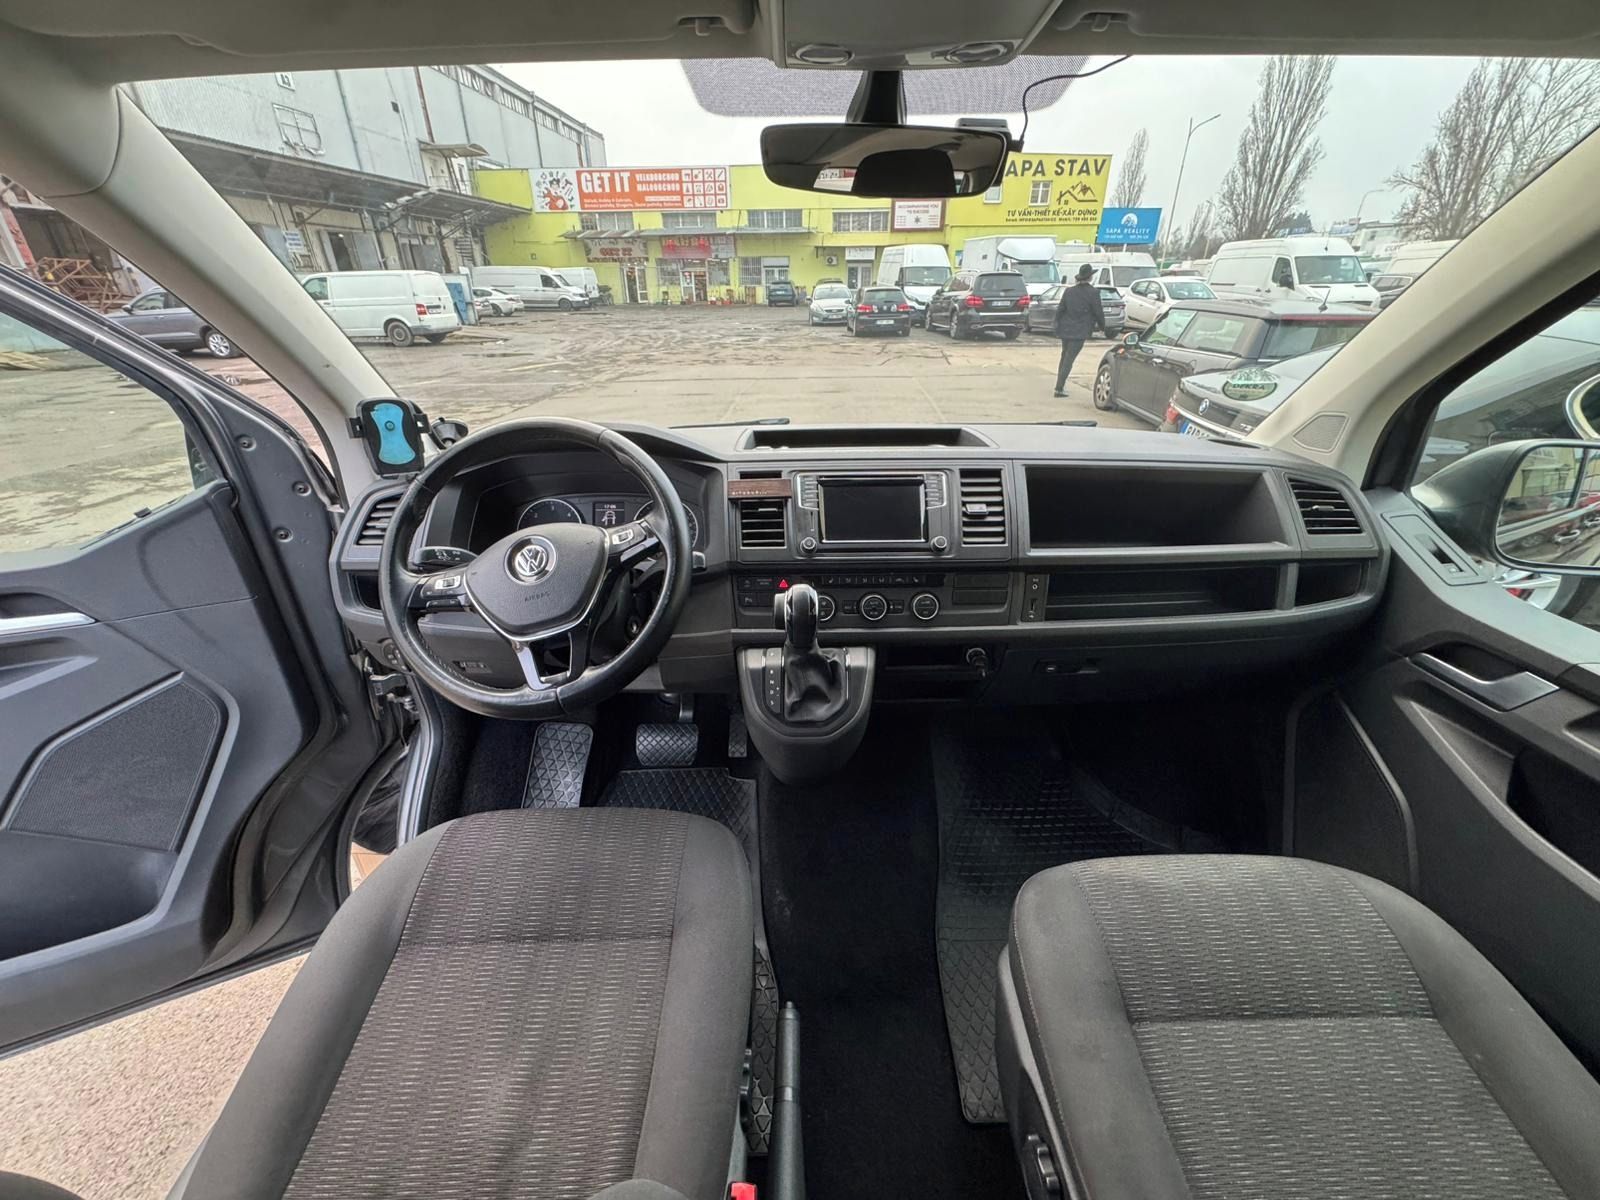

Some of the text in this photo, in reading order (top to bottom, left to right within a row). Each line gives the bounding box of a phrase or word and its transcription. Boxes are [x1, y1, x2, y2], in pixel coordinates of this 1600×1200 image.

[1005, 158, 1108, 177] APA STAV
[580, 171, 631, 193] GET IT
